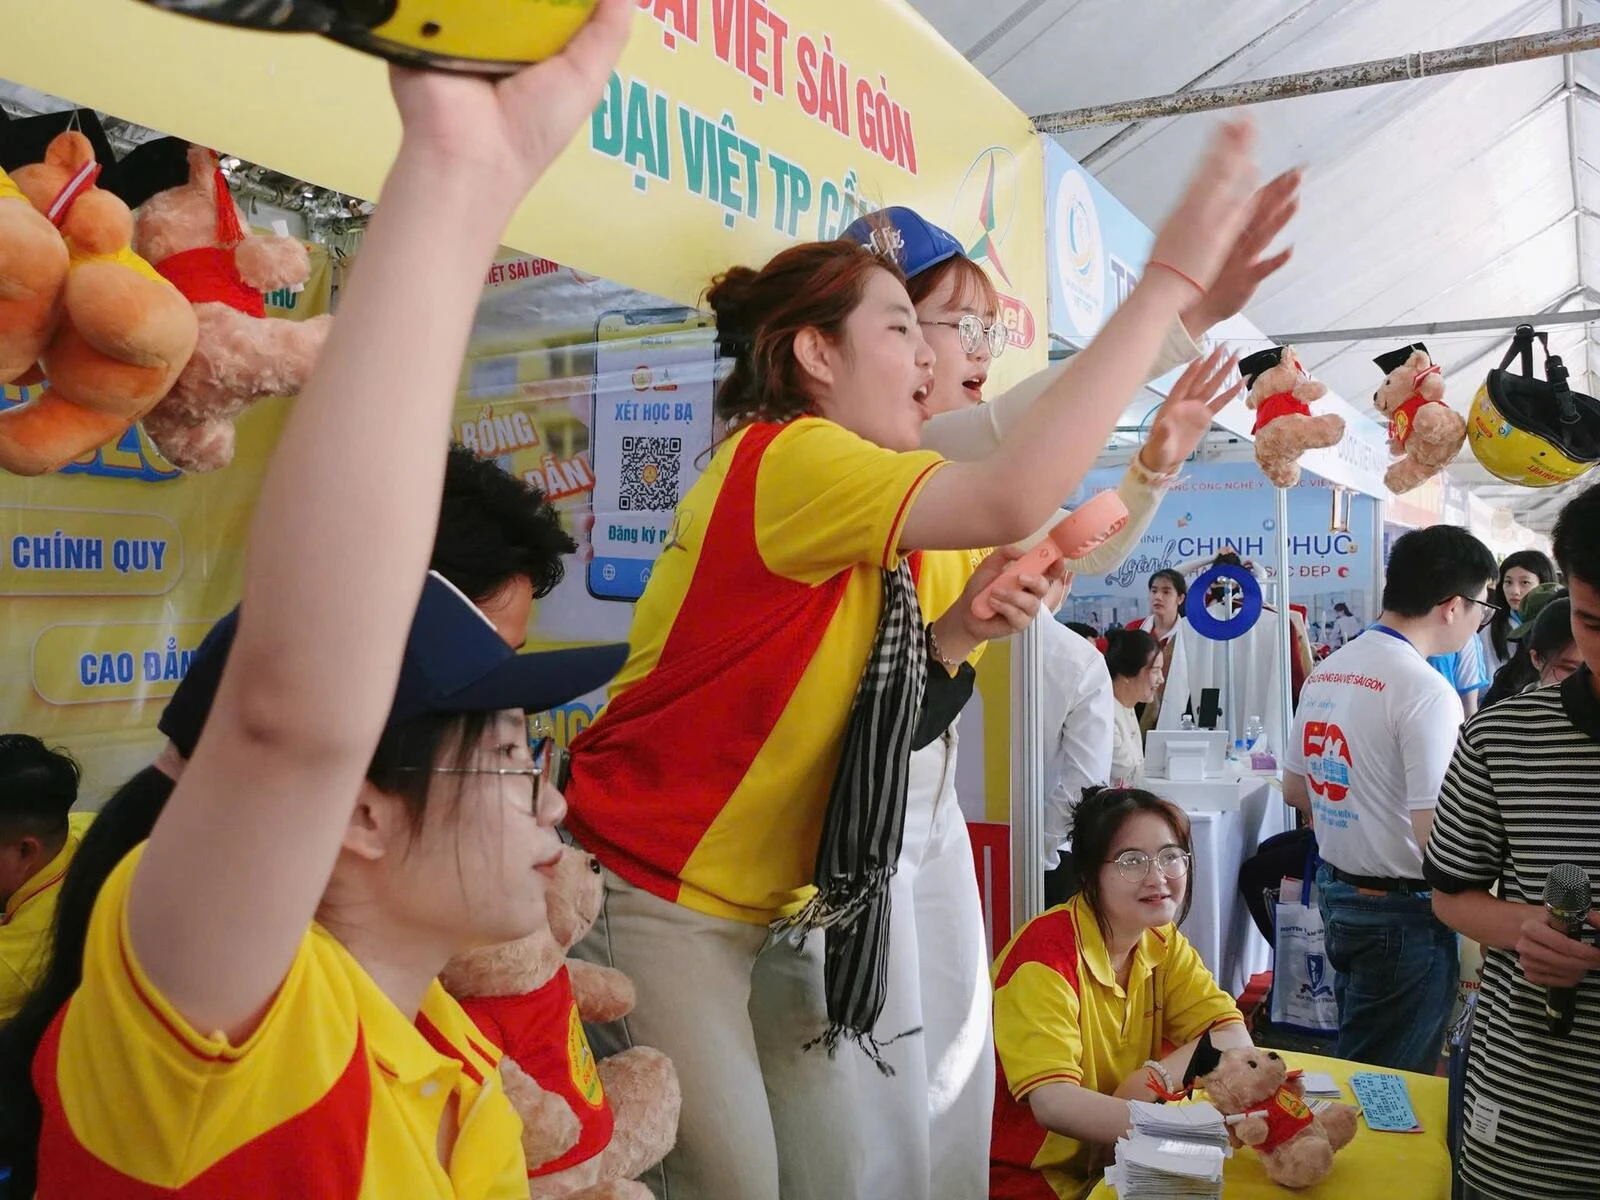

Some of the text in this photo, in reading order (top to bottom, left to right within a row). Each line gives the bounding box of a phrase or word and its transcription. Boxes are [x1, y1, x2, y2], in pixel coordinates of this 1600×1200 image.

[711, 0, 788, 103] VIỆT
[797, 34, 850, 137] SÀI
[857, 75, 917, 175] GÒN
[592, 70, 670, 191] ĐẠI
[679, 112, 761, 229] VIỆT
[768, 154, 812, 237] TP
[485, 262, 504, 287] IỆT
[615, 400, 693, 425] XÉT HỌC BẠ
[608, 524, 638, 544] Đăng
[642, 526, 656, 544] ký
[13, 531, 166, 573] CHÍNH QUY
[80, 653, 133, 685] CAO
